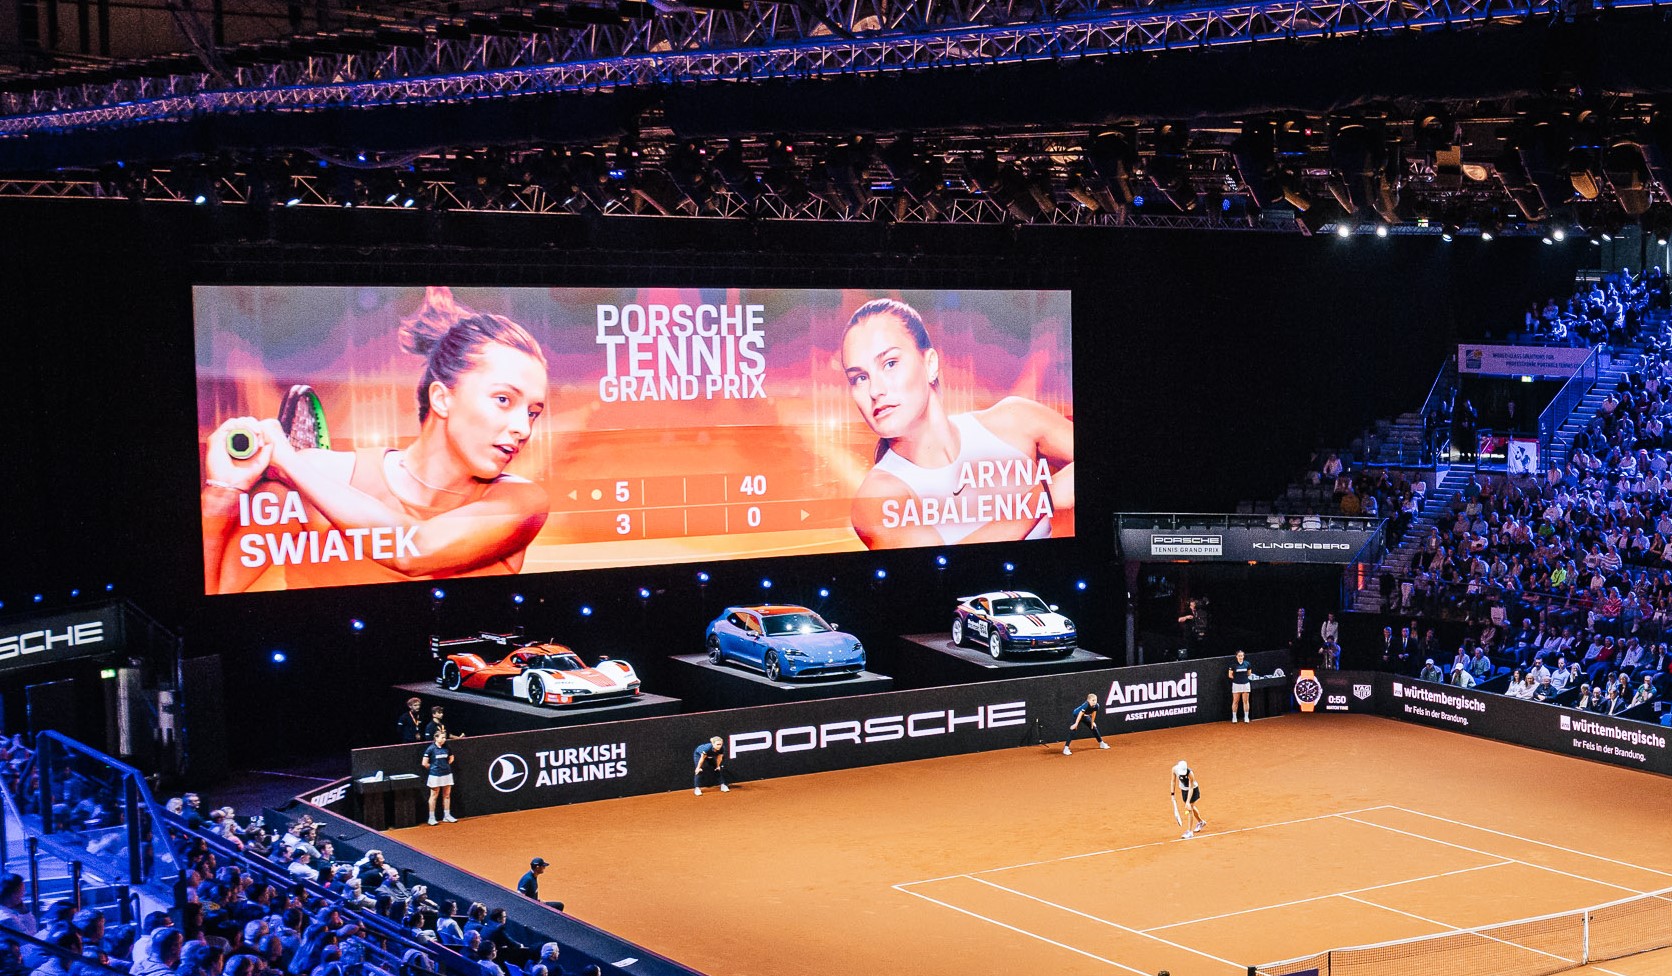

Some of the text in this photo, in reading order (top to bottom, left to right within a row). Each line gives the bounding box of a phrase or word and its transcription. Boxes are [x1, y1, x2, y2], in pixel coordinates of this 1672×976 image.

[596, 304, 765, 337] PORSCHE
[596, 334, 766, 377] TENNIS
[599, 374, 767, 402] GRAND PRIX
[959, 458, 1053, 489] ARYNA
[615, 475, 767, 502] 5 40
[239, 490, 309, 527] IGA
[616, 507, 761, 535] 3 0
[882, 492, 1054, 528] SABALENKA
[239, 526, 422, 568] SWIATEK
[1252, 542, 1350, 550] KLINGENBERG
[0, 621, 104, 660] SCHE
[1106, 672, 1198, 706] Amundi
[1328, 695, 1347, 704] 0:50
[1403, 685, 1486, 712] württembergische
[1125, 705, 1198, 722] ASSET MANAGEMENT
[1404, 705, 1469, 726] Ihr Fels in der Brandung.
[729, 701, 1026, 759] PORSCHE
[1572, 719, 1666, 748] württembergische
[535, 743, 626, 768] TURKISH
[1573, 739, 1646, 763] Ihr Fels in der Brandung.
[535, 761, 628, 788] AIRLINES
